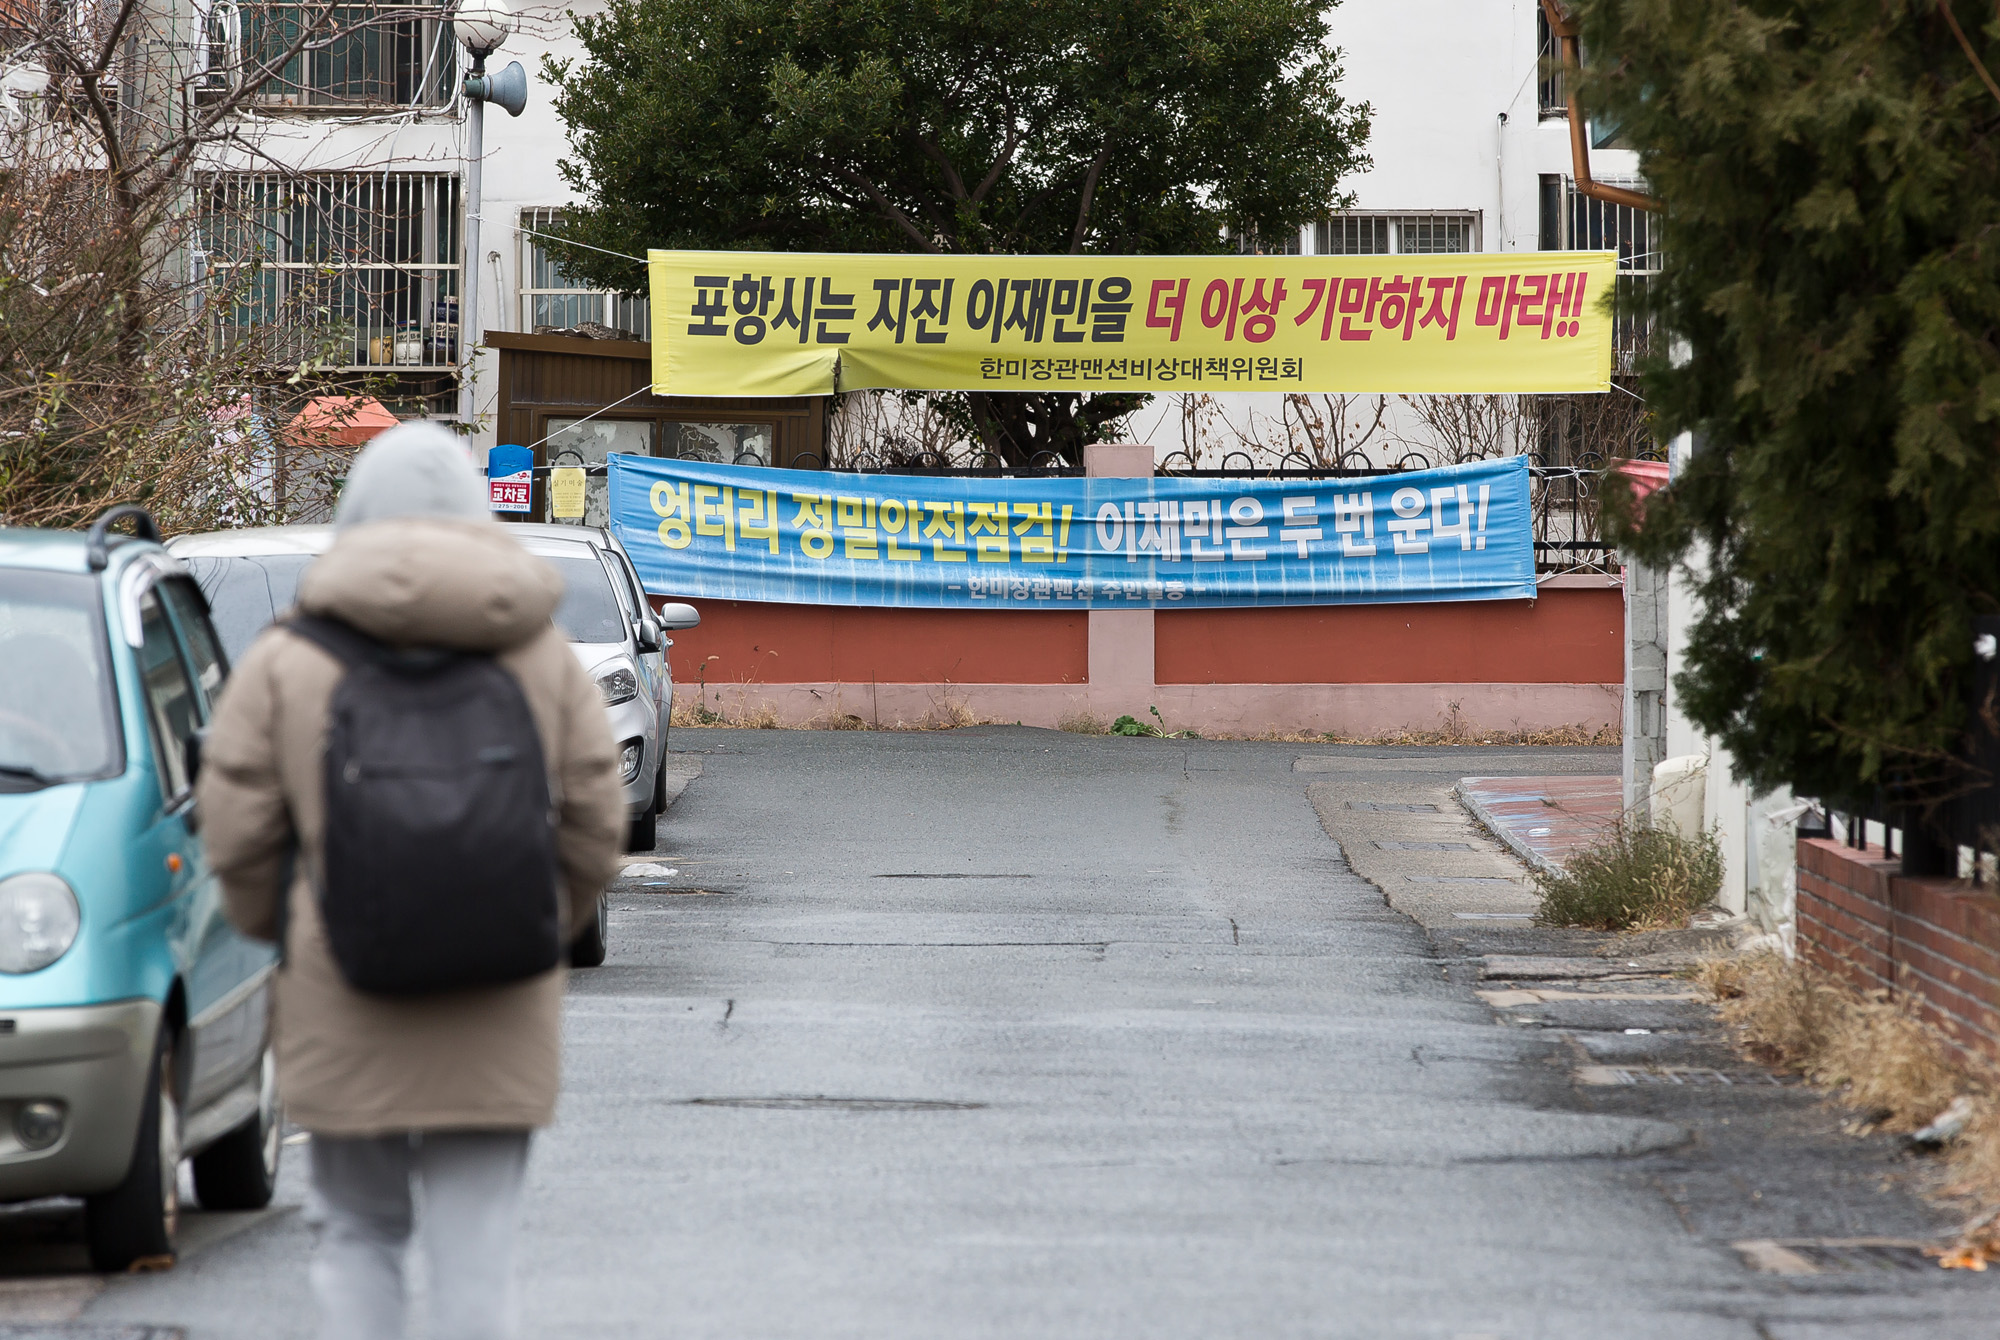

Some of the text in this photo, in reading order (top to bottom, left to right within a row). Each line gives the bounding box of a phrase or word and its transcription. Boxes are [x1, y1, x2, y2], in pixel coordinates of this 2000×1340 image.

[687, 272, 1586, 345] 포항시는 지진 이재민을 더 이상 기만하지 마라!!
[980, 358, 1303, 380] 한미장관맨션비상대책위원회
[493, 487, 527, 502] 교차로
[649, 481, 1490, 563] 엉터리 정밀안전점검! 이재민은 두 번 운다!
[1102, 580, 1186, 601] 주민일동
